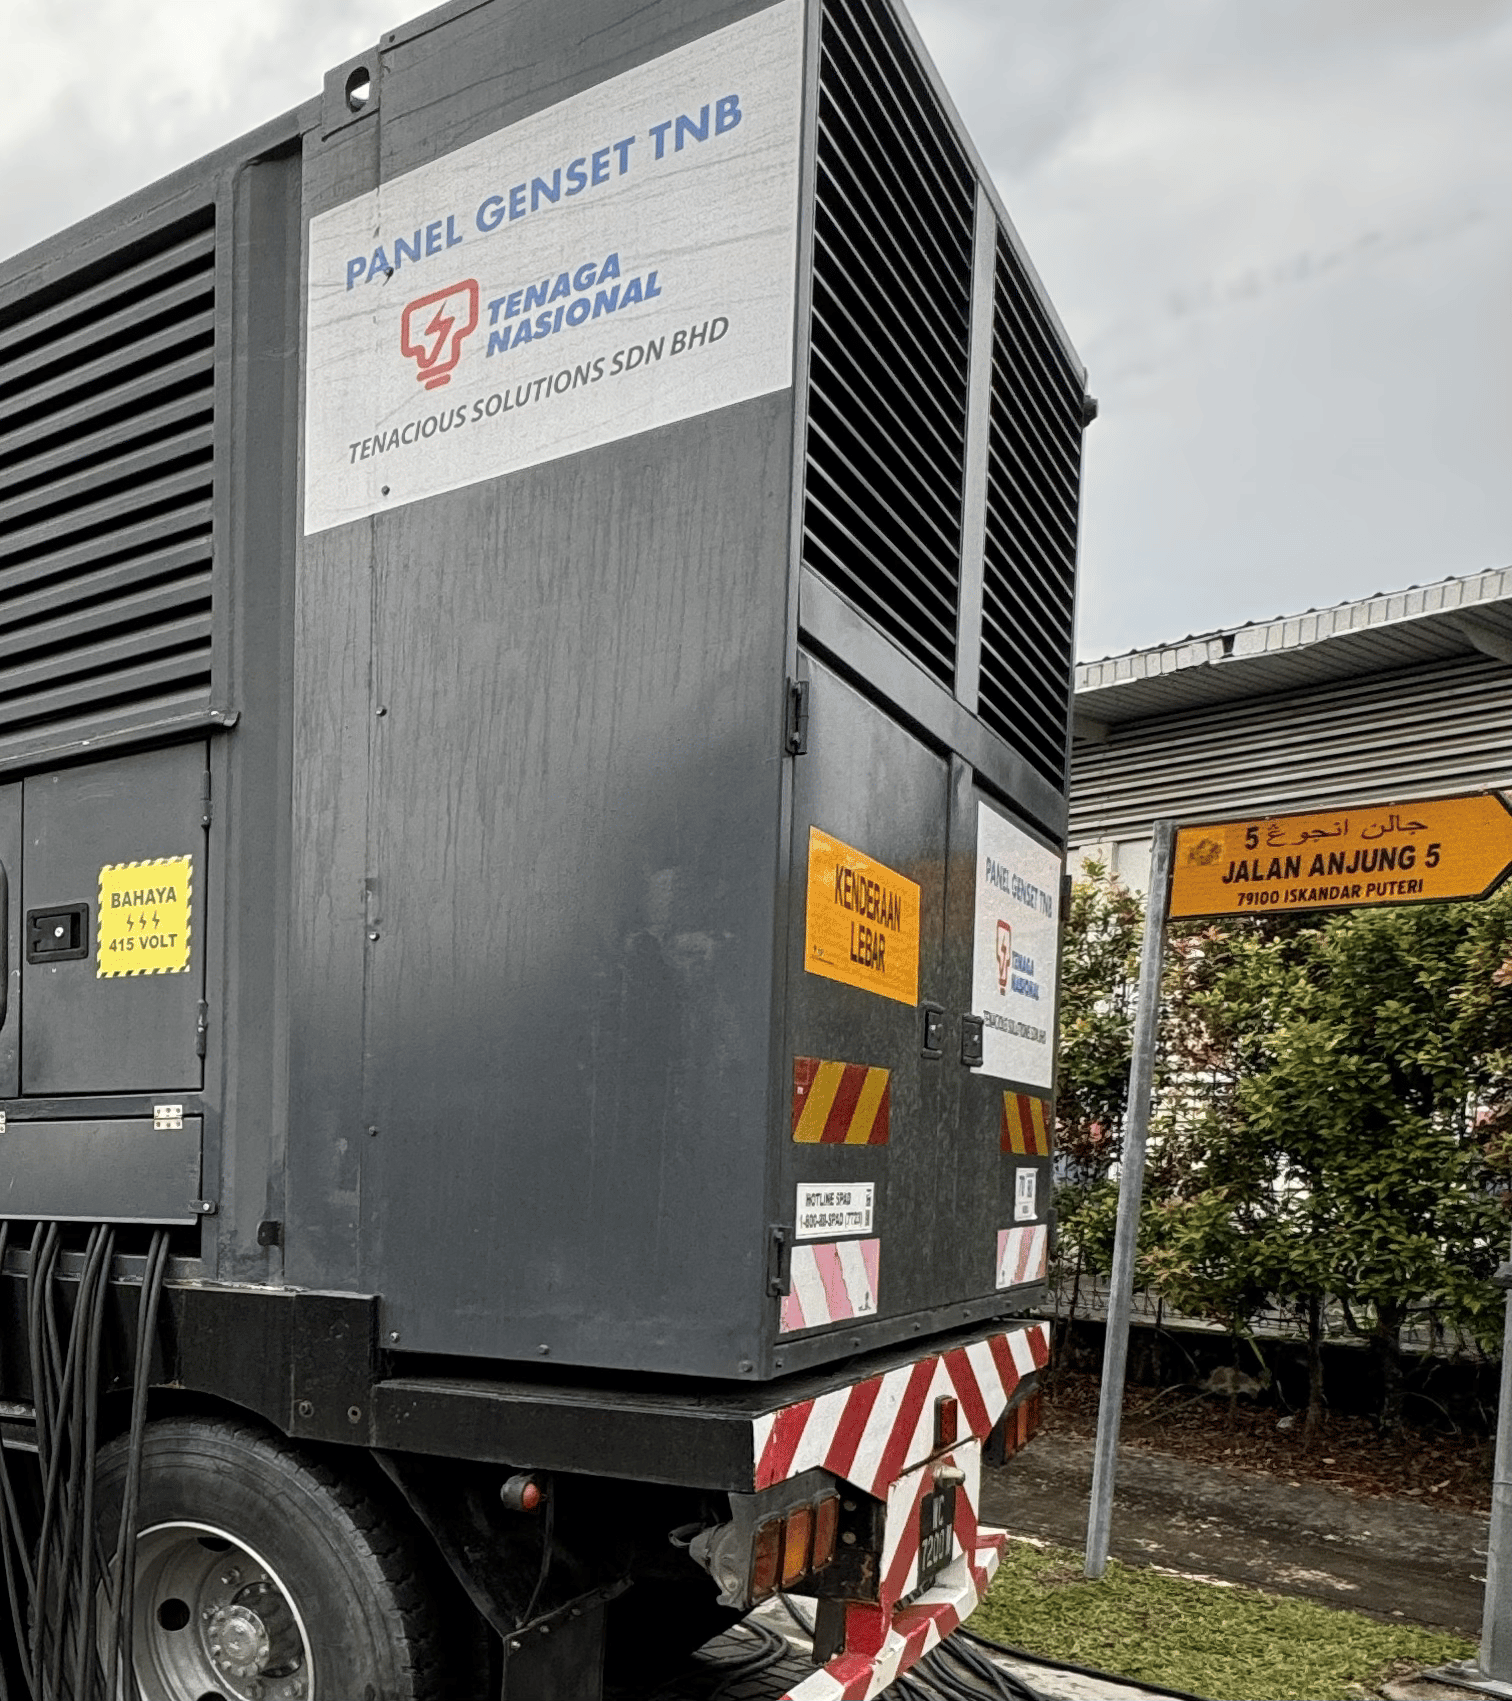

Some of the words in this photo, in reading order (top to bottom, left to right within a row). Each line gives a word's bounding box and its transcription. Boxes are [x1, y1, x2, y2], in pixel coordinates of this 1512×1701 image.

[346, 215, 463, 291] PANEL
[475, 136, 636, 233] GENSET
[649, 94, 742, 161] TNB
[488, 252, 621, 326] TENAGA
[485, 270, 662, 358] NASIONAL
[349, 404, 467, 464] TENACIOUS
[471, 357, 605, 422] SOLUTIONS
[610, 337, 665, 376] SDN
[669, 316, 730, 356] BHD
[1245, 826, 1260, 850] 5
[1361, 814, 1428, 840] جالن
[1222, 855, 1301, 884] JALAN
[1308, 845, 1416, 877] ANJUNG
[1425, 843, 1441, 868] 5
[111, 886, 177, 909] BAHAYA
[835, 863, 901, 933] KENDERAAN
[1238, 890, 1279, 906] 79100
[1284, 884, 1363, 903] ISKANDAR
[1365, 879, 1424, 897] PUTERI
[109, 936, 135, 952] 415
[139, 933, 178, 950] VOLT
[850, 921, 885, 974] LEBAR
[805, 1192, 834, 1207] HOTLINE
